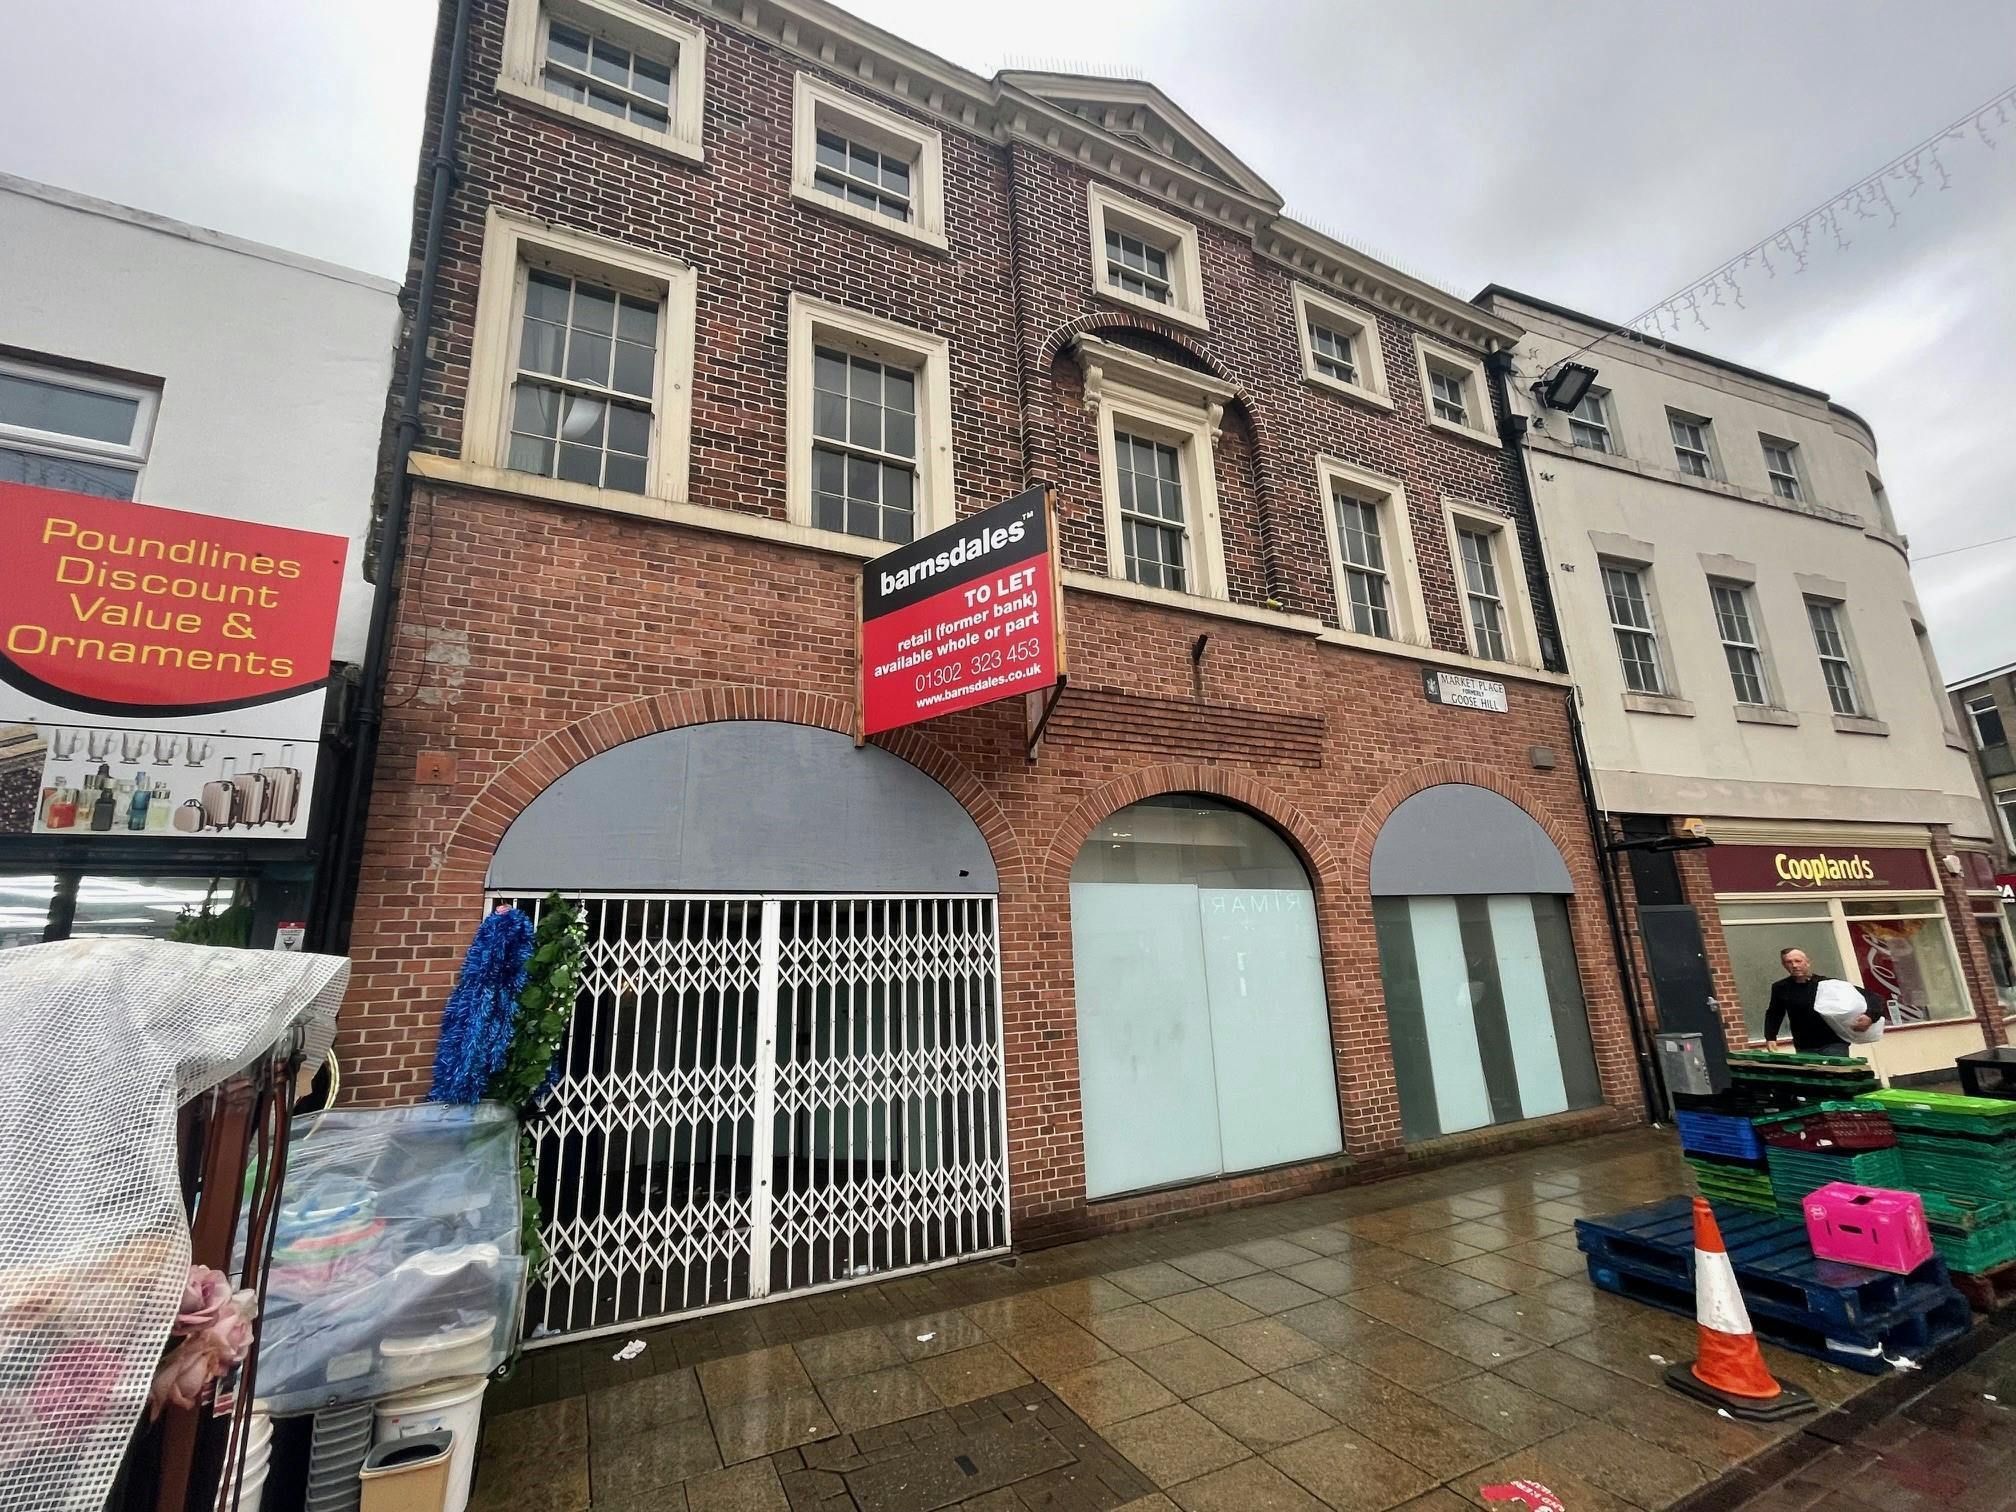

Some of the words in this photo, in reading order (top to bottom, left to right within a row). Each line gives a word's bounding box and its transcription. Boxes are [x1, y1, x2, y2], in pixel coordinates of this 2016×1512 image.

[42, 517, 301, 579] Poundlines
[56, 555, 279, 608] Discount
[964, 584, 991, 608] TO
[997, 566, 1037, 597] LET
[70, 593, 202, 634] Value
[222, 612, 257, 640] &
[898, 628, 932, 652] retail
[936, 608, 989, 641] (former
[993, 590, 1038, 618] bank)
[7, 624, 296, 678] Ornaments
[874, 648, 933, 678] available
[937, 632, 980, 657] whole
[984, 625, 1001, 641] or
[1006, 611, 1039, 637] part
[915, 663, 962, 693] 01302
[971, 649, 1002, 676] 323
[1006, 638, 1040, 663] 453
[916, 663, 1042, 708] www.barnsdales.co.uk
[1441, 675, 1475, 689] MARKET
[1479, 681, 1503, 693] PLACE
[1451, 693, 1477, 706] GOOSE
[1481, 699, 1498, 710] HILL
[1462, 688, 1484, 697] FORMERLY
[1775, 853, 1875, 887] Cooplands
